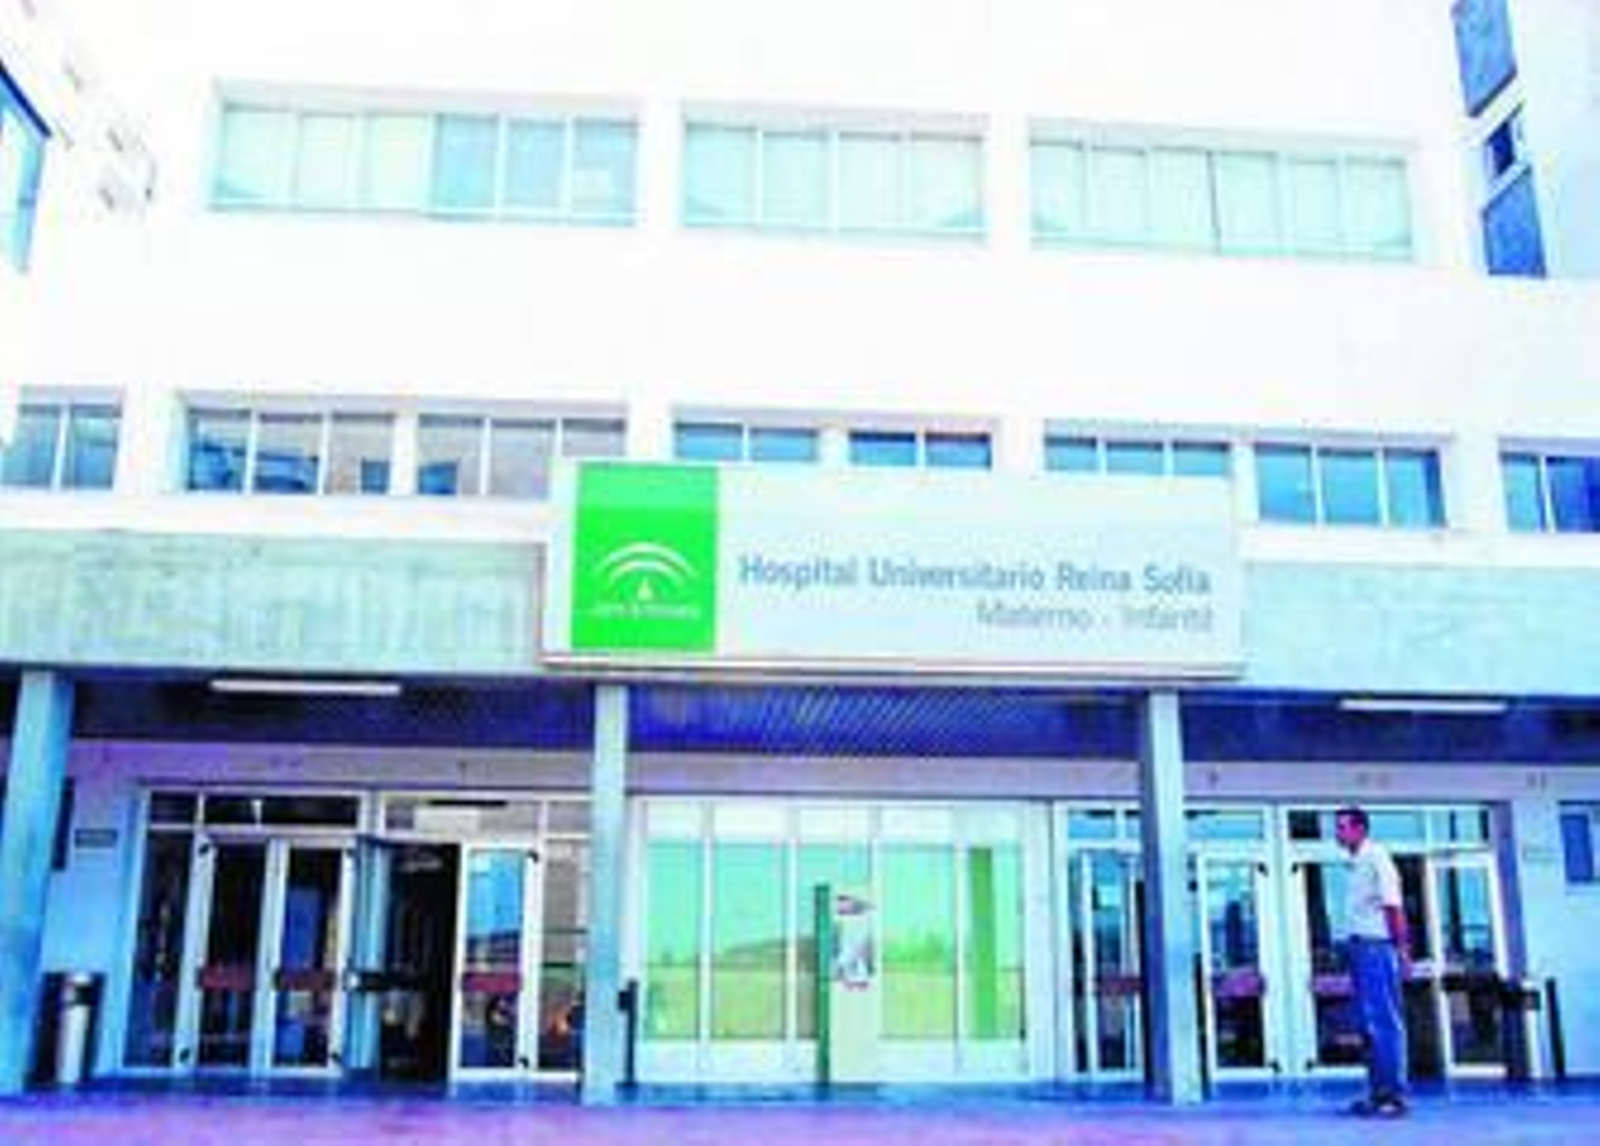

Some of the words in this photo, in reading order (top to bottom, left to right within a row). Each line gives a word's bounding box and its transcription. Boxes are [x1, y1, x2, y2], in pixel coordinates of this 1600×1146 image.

[739, 554, 858, 591] Hospital
[868, 556, 1045, 592] Universitario
[1057, 562, 1132, 591] Reina
[977, 601, 1092, 630] Materno
